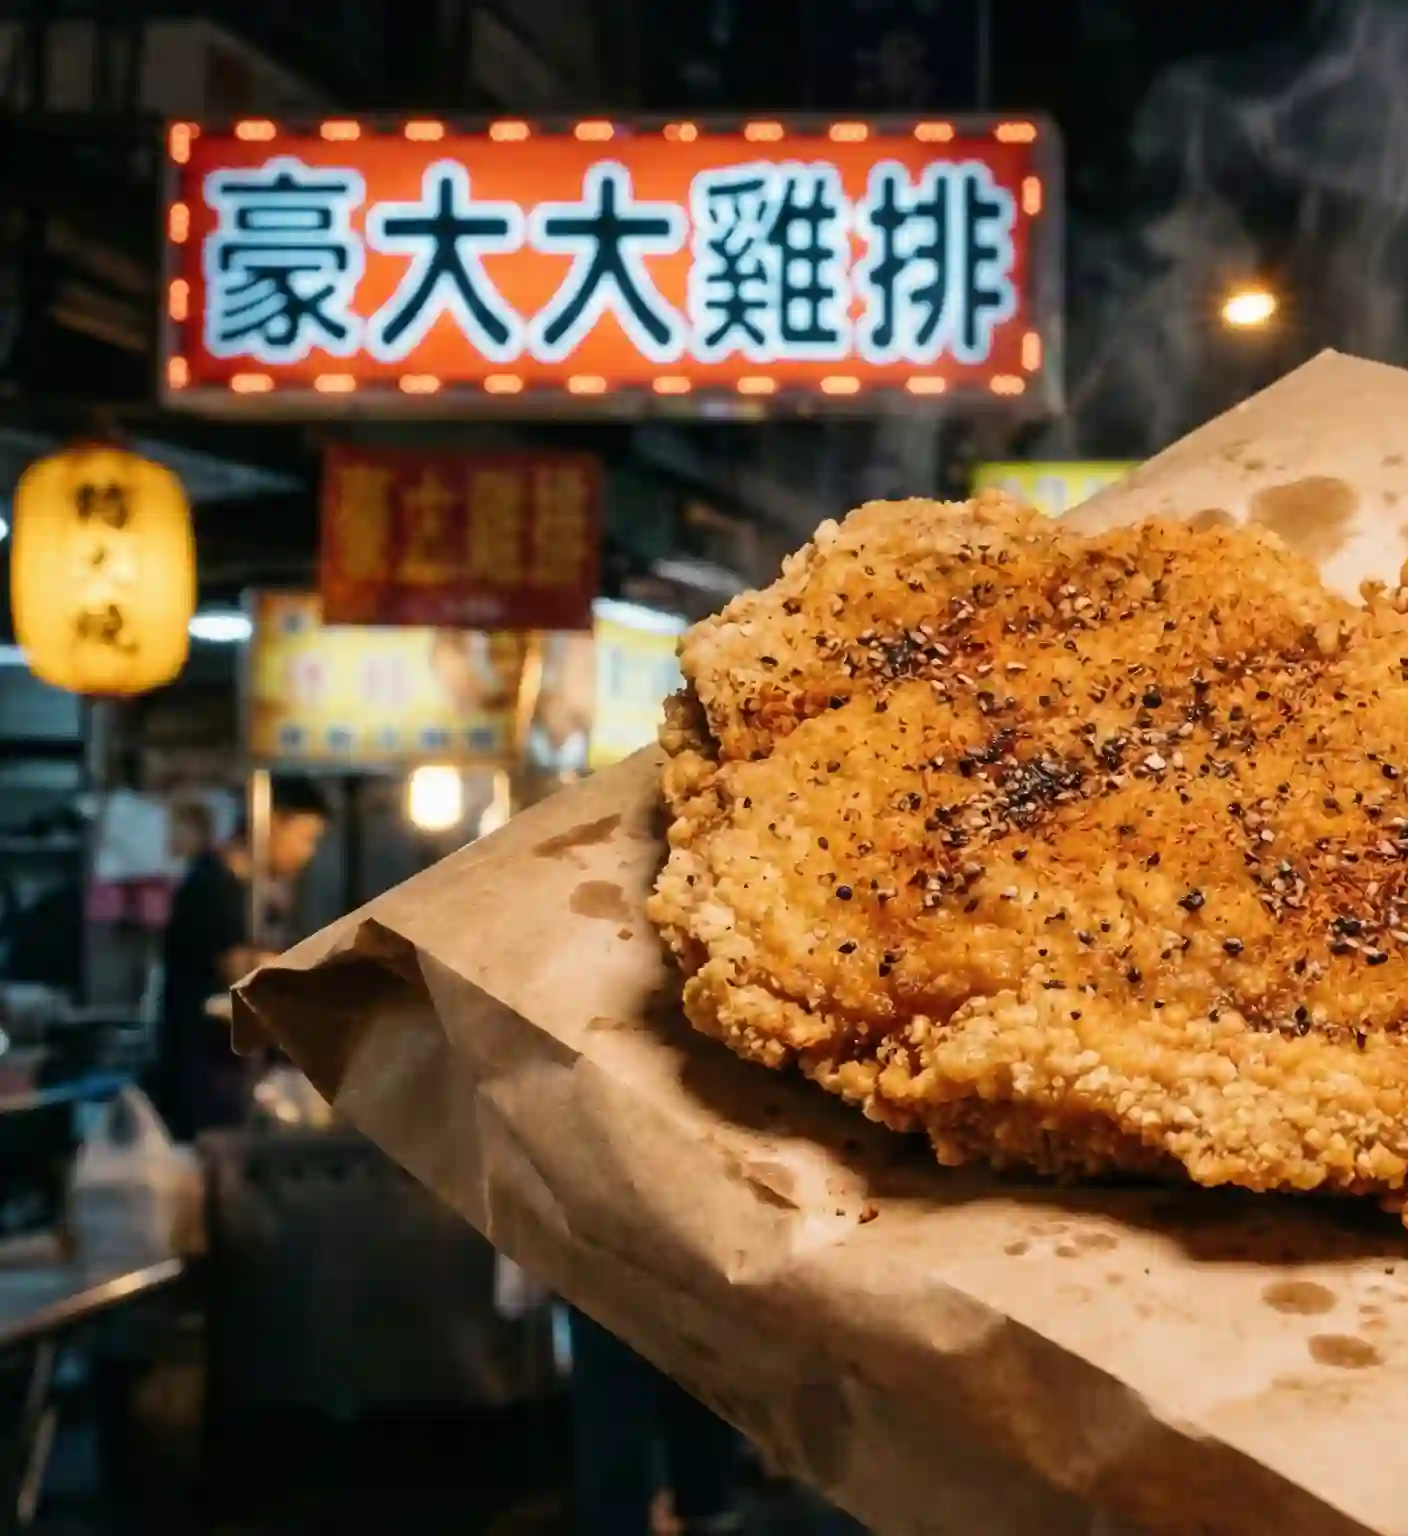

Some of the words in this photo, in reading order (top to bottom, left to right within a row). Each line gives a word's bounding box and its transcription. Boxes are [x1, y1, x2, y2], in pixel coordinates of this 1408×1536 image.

[213, 170, 1004, 352] 豪大大雞排
